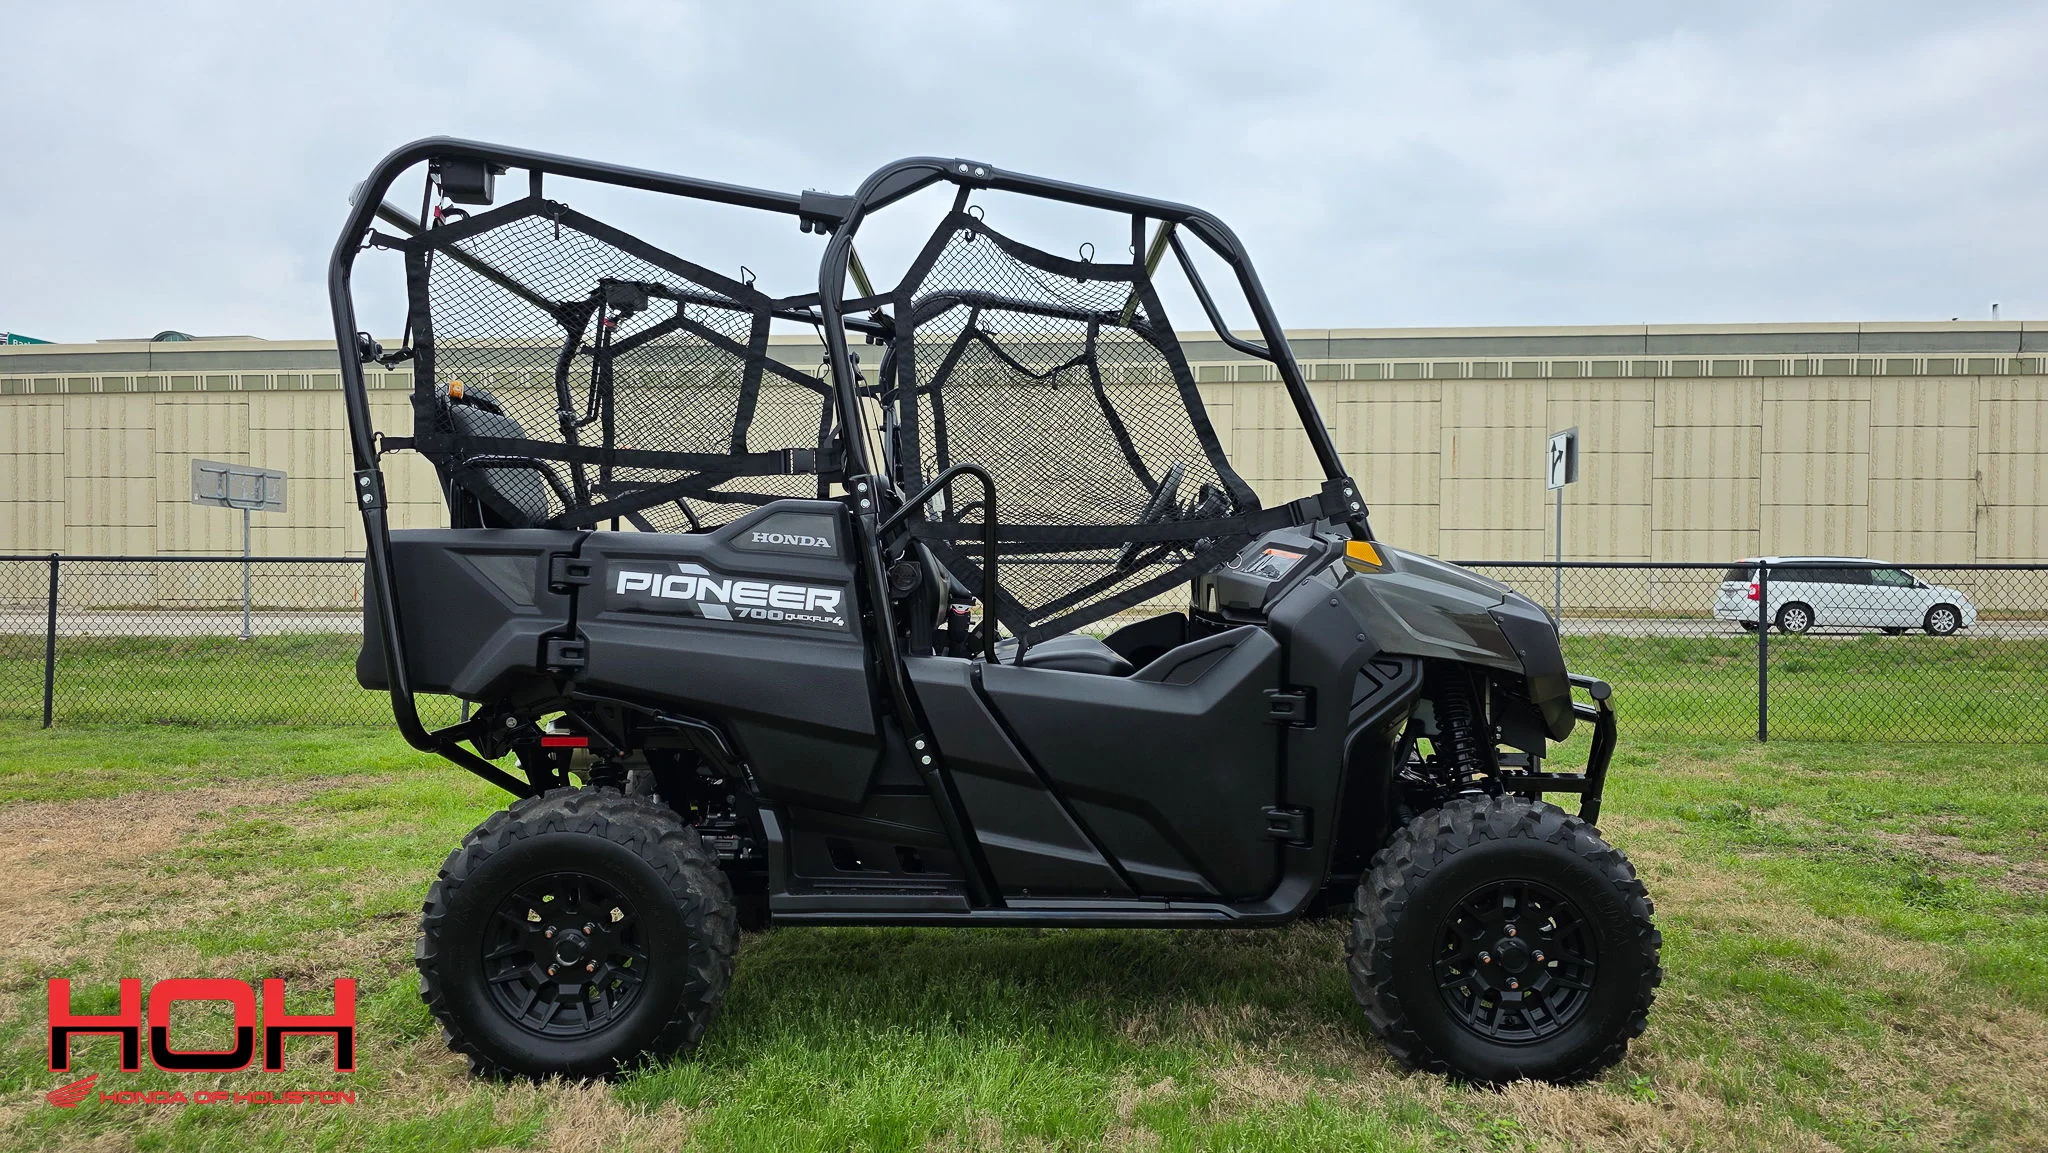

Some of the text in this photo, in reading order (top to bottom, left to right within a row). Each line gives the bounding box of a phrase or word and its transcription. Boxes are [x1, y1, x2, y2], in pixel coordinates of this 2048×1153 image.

[752, 532, 831, 548] HONDA
[616, 571, 841, 613] PIONEER
[734, 606, 784, 621] 700
